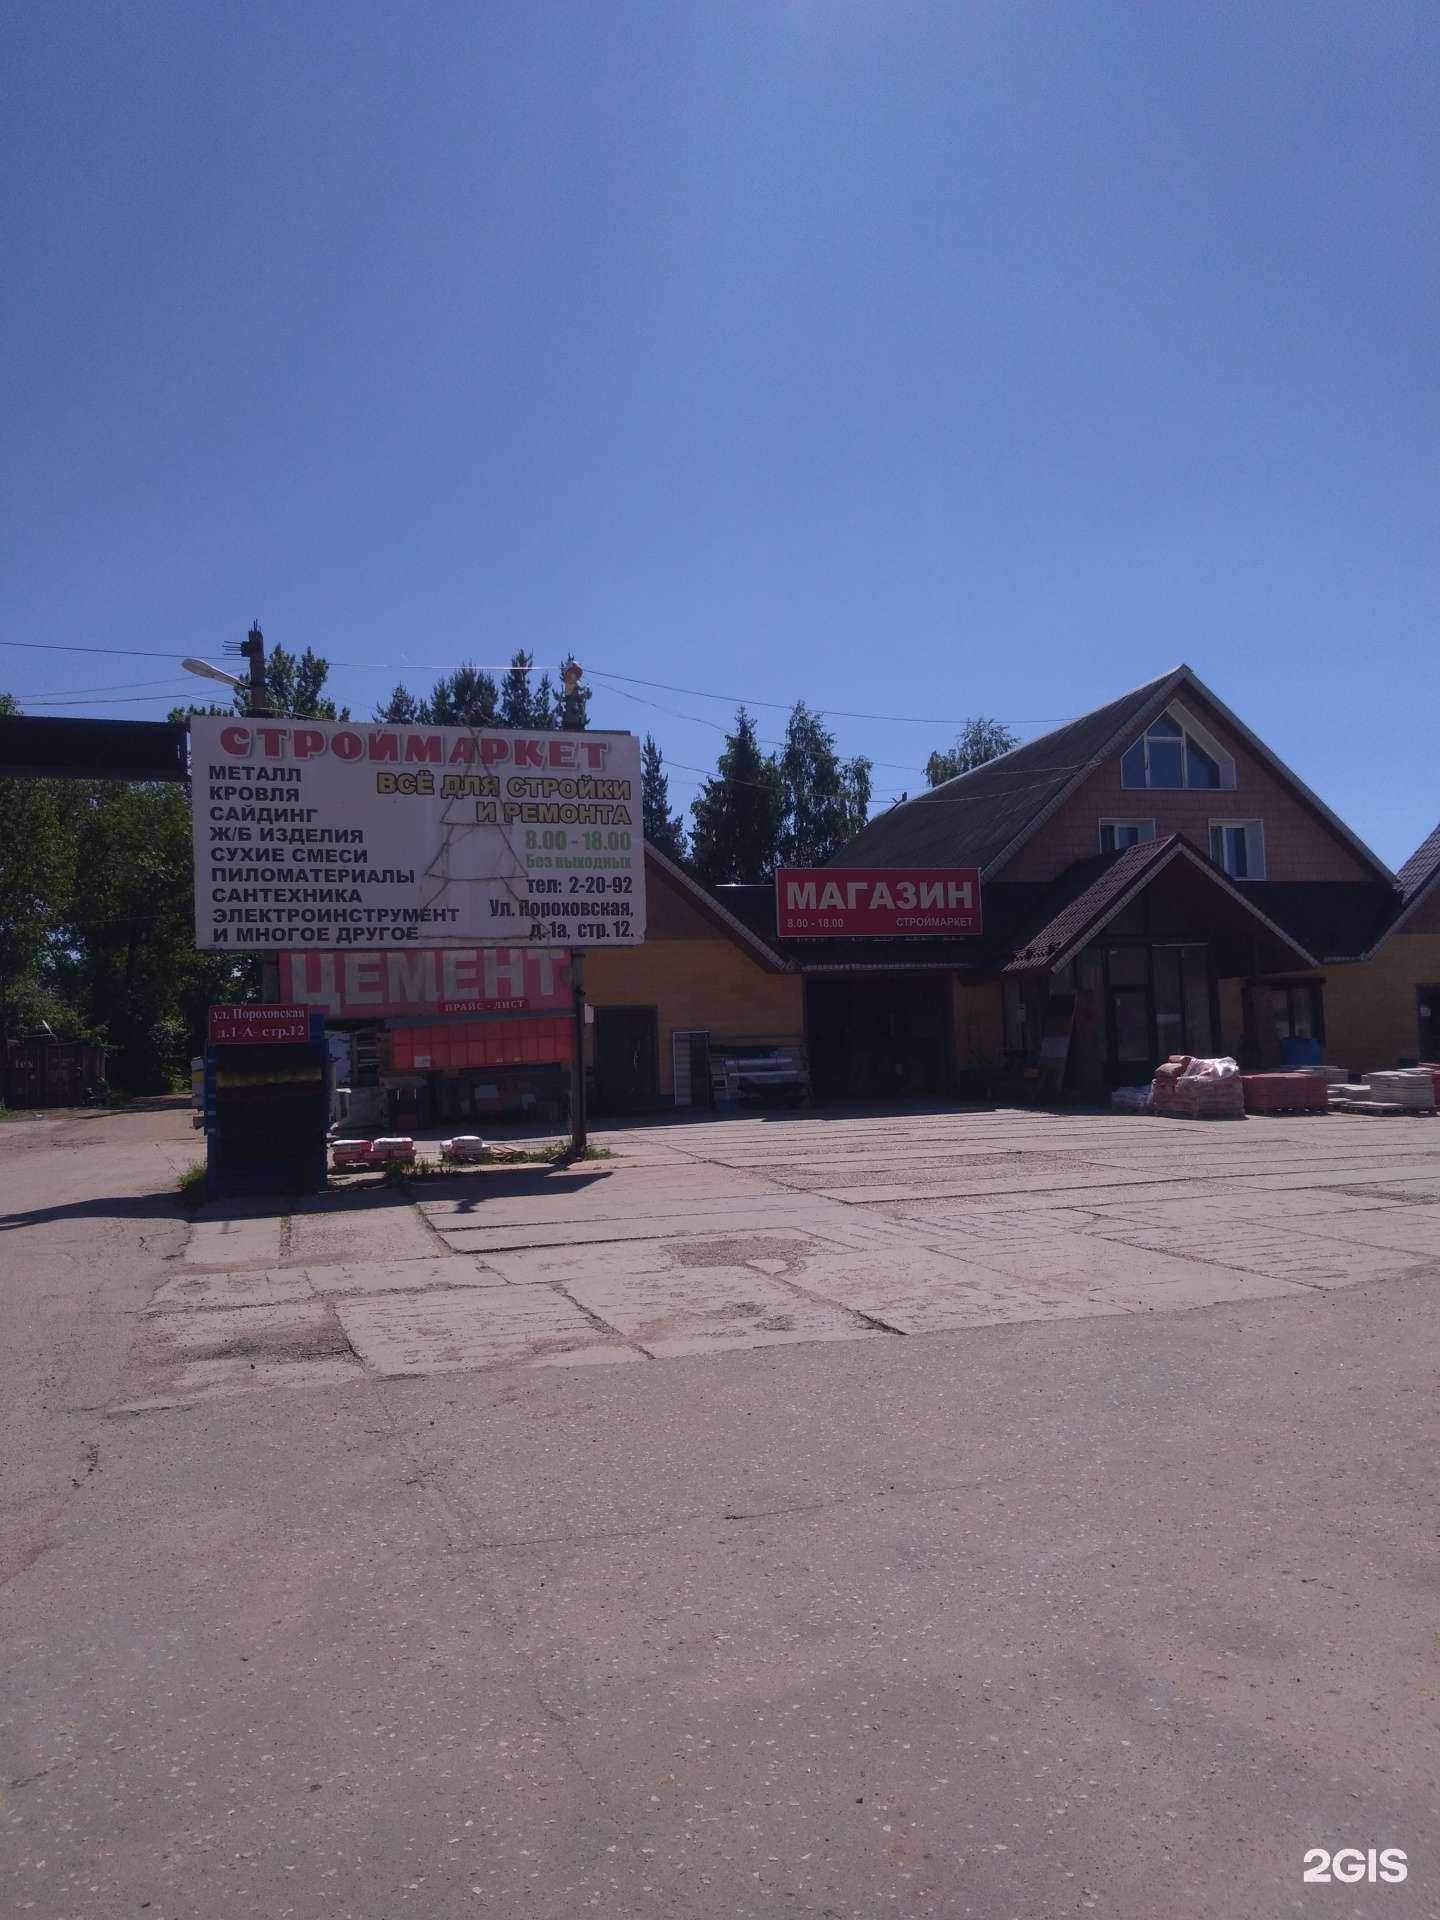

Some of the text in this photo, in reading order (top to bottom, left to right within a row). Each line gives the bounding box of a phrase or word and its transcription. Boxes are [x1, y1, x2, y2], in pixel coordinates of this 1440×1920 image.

[219, 726, 607, 770] СТРОЙМАРКЕТ
[208, 766, 302, 782] МЕТАЛЛ
[209, 786, 300, 802] КРОВЛЯ
[376, 770, 632, 800] ВСЁ ДЛЯ СТРОЙКИ
[209, 805, 318, 824] САЙДИНГ
[476, 801, 632, 825] И РЕМОНТА
[209, 827, 364, 845] Ж/Б ИЗДЕЛИЯ
[525, 830, 567, 850] 8.00
[582, 831, 631, 851] 18.00
[210, 847, 368, 863] СУХИЕ СМЕСИ
[526, 854, 632, 870] Без выходных
[211, 868, 415, 883] ПИЛОМАТЕРИАЛЫ
[526, 876, 633, 894] тел: 2-20-92
[211, 888, 363, 903] САНТЕХНИКА
[786, 881, 973, 910] МАГАЗИН
[212, 907, 459, 923] ЭЛЕКТРОИНСТРУМЕНТ
[489, 899, 634, 919] Ул. Пороховская,
[213, 926, 419, 944] И МНОГОЕ ДРУГОЕ
[290, 950, 565, 1015] ЦЕМЕНТ
[213, 1008, 305, 1022] ул. Пороховская
